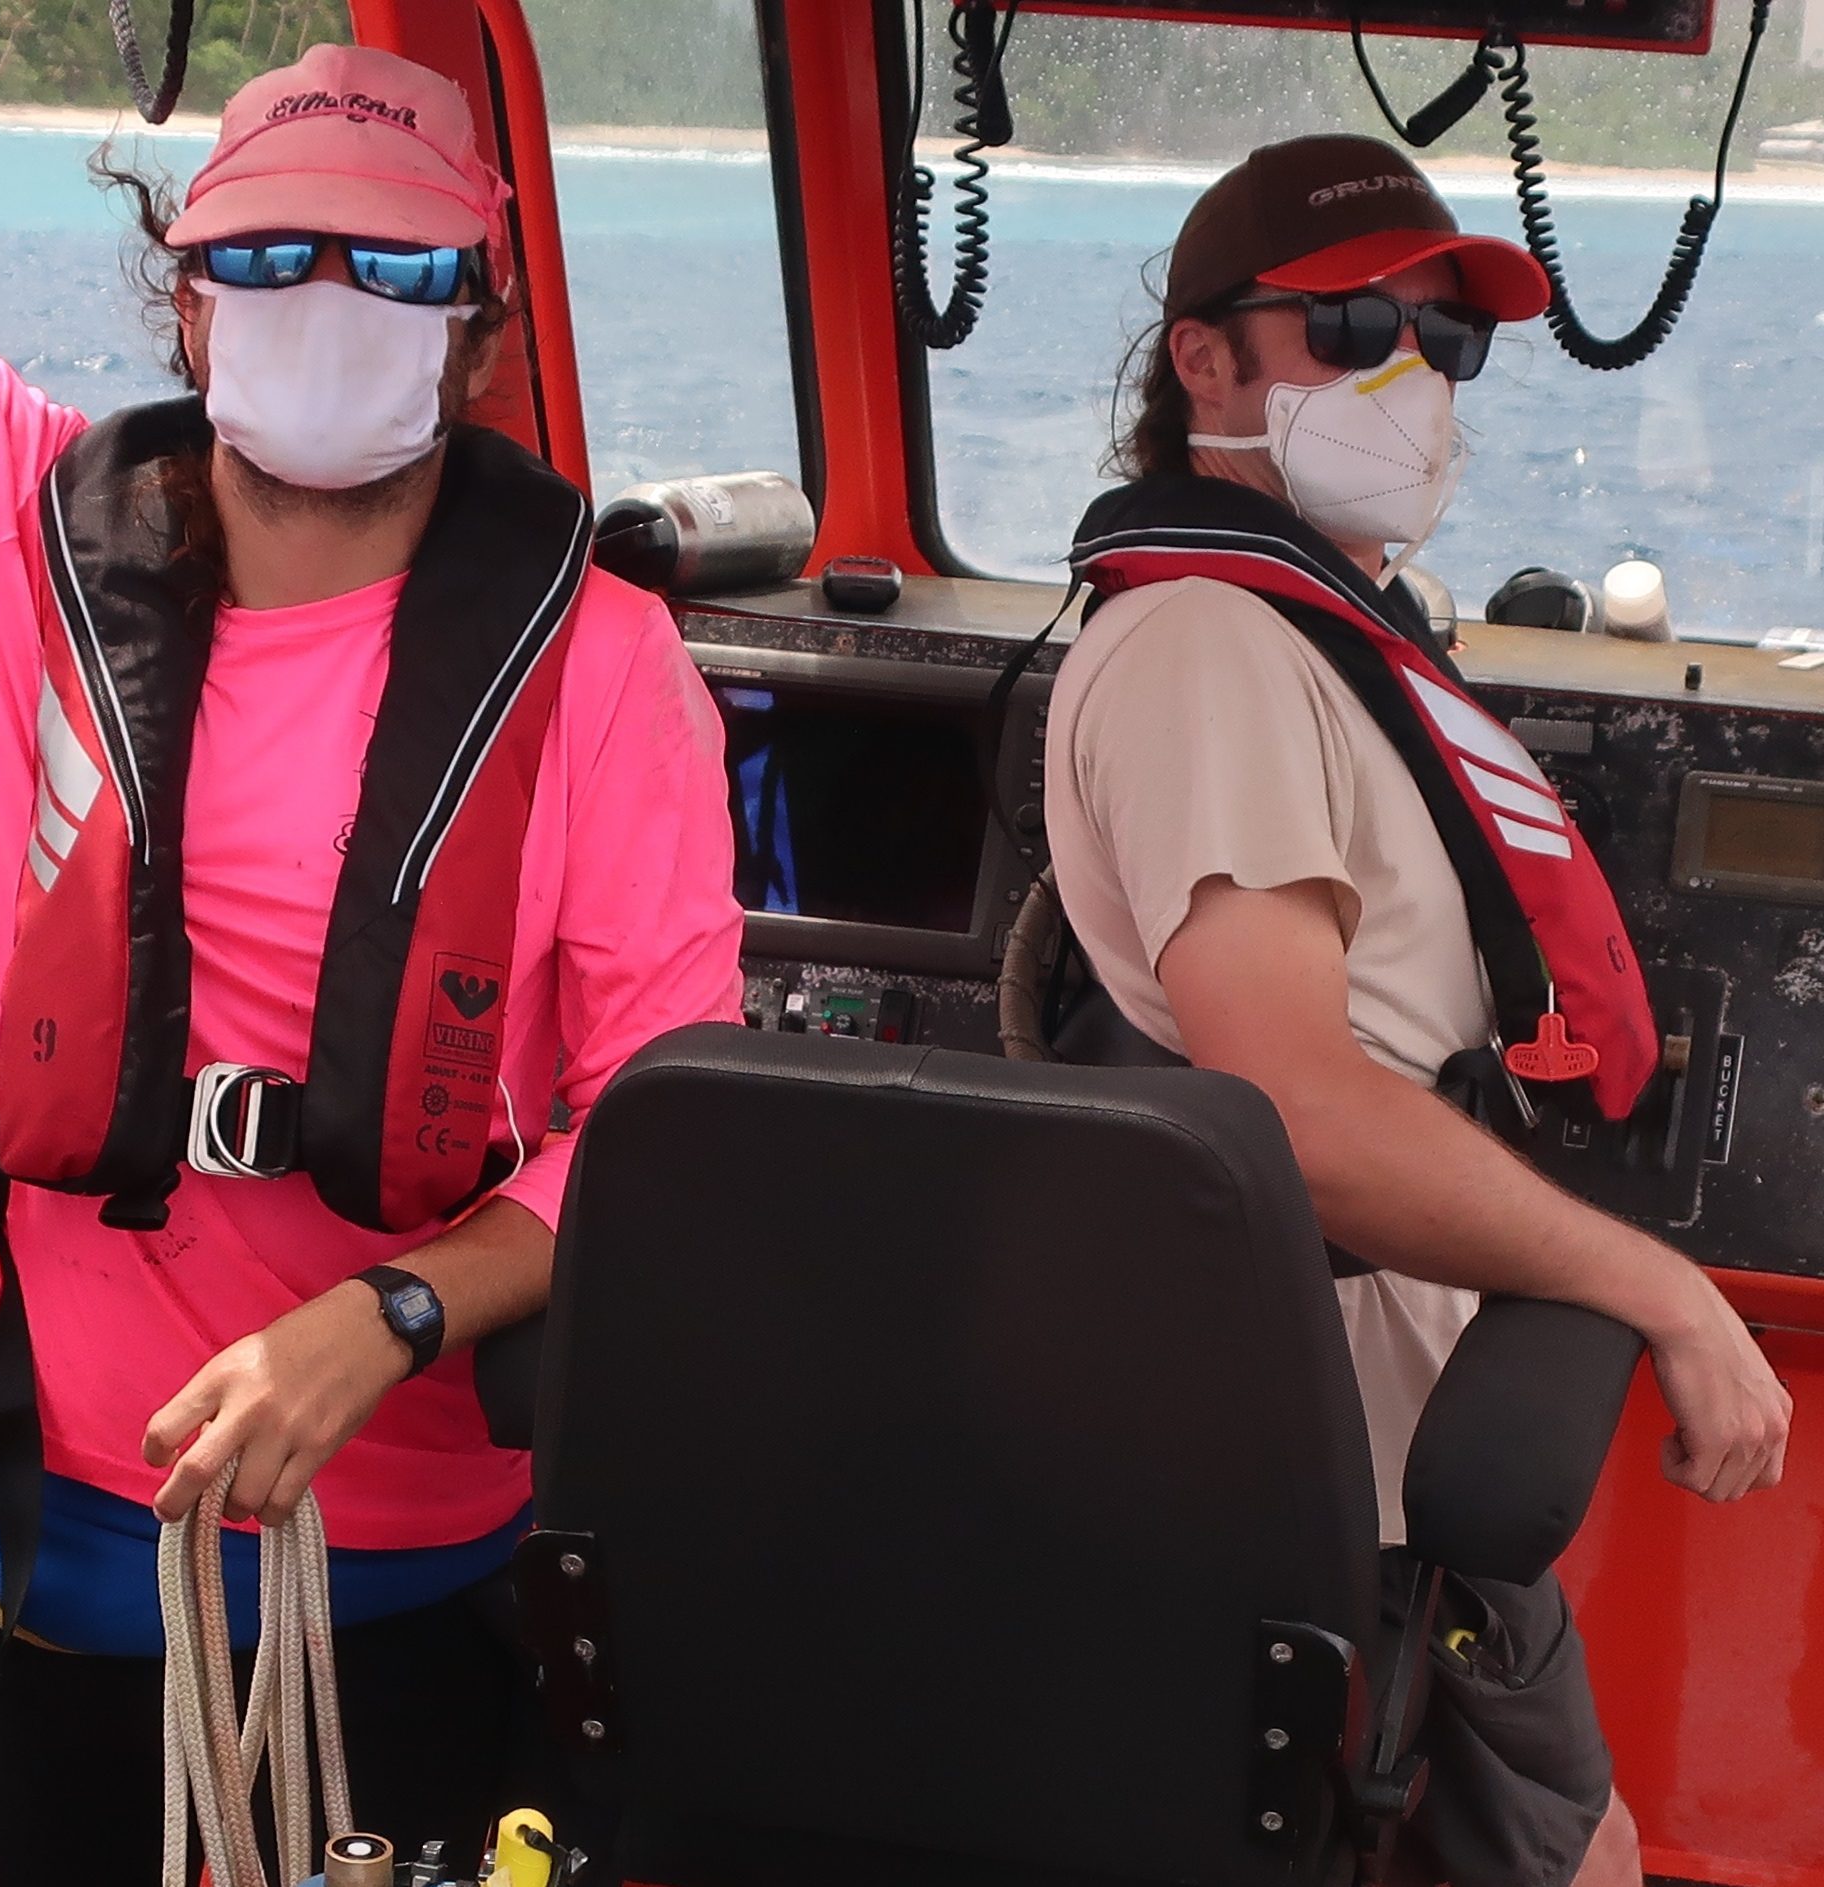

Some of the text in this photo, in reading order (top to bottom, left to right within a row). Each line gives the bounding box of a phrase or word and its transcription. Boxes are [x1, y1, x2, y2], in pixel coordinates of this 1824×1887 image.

[32, 1017, 57, 1063] 9
[434, 1025, 494, 1052] VIKING
[1713, 1055, 1733, 1142] BUCKET
